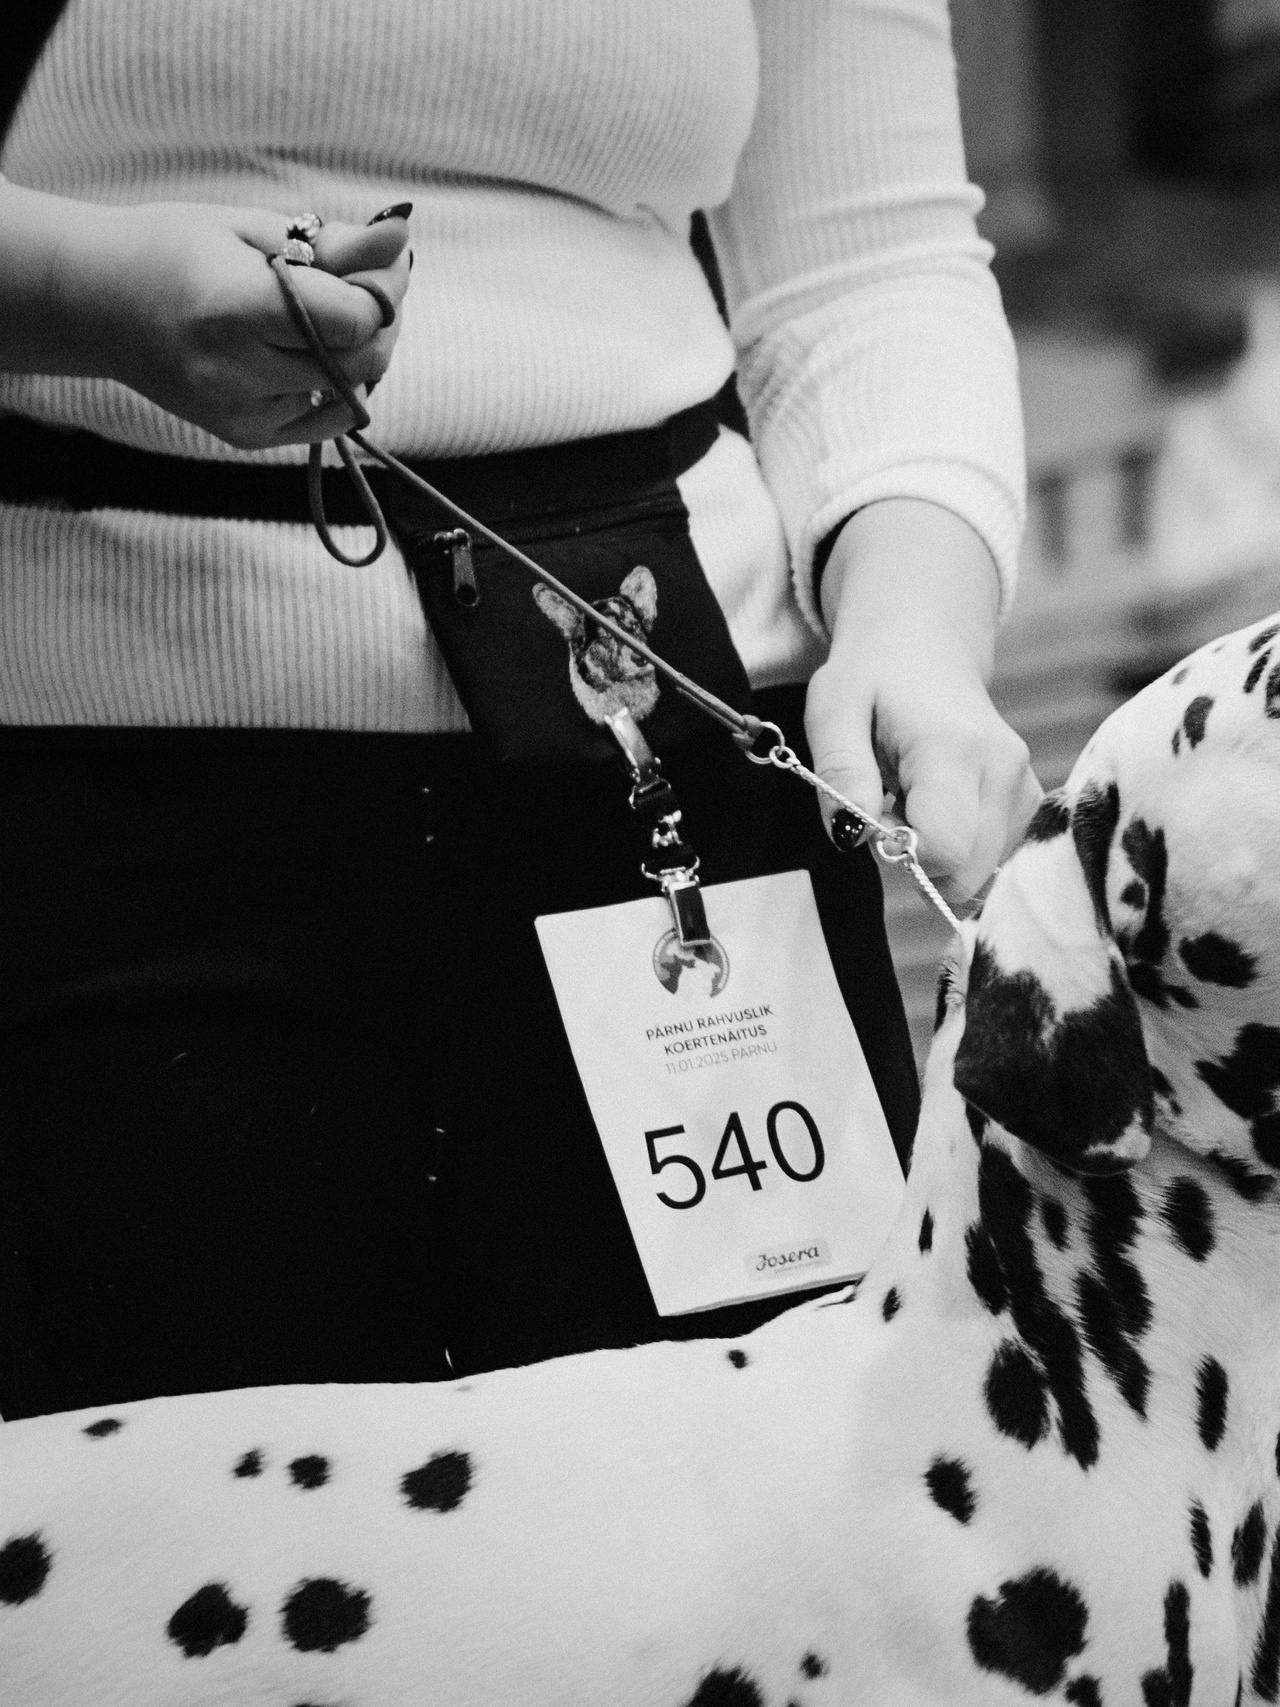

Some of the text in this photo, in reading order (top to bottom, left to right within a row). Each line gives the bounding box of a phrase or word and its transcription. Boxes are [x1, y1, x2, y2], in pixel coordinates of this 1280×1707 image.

[645, 1005, 773, 1041] PÄRNU RAHVUSLIK
[663, 1025, 768, 1056] KOERTENÄITUS
[665, 1054, 729, 1074] 11.01.2025
[644, 1100, 825, 1210] 540
[755, 1245, 821, 1272] Josera
